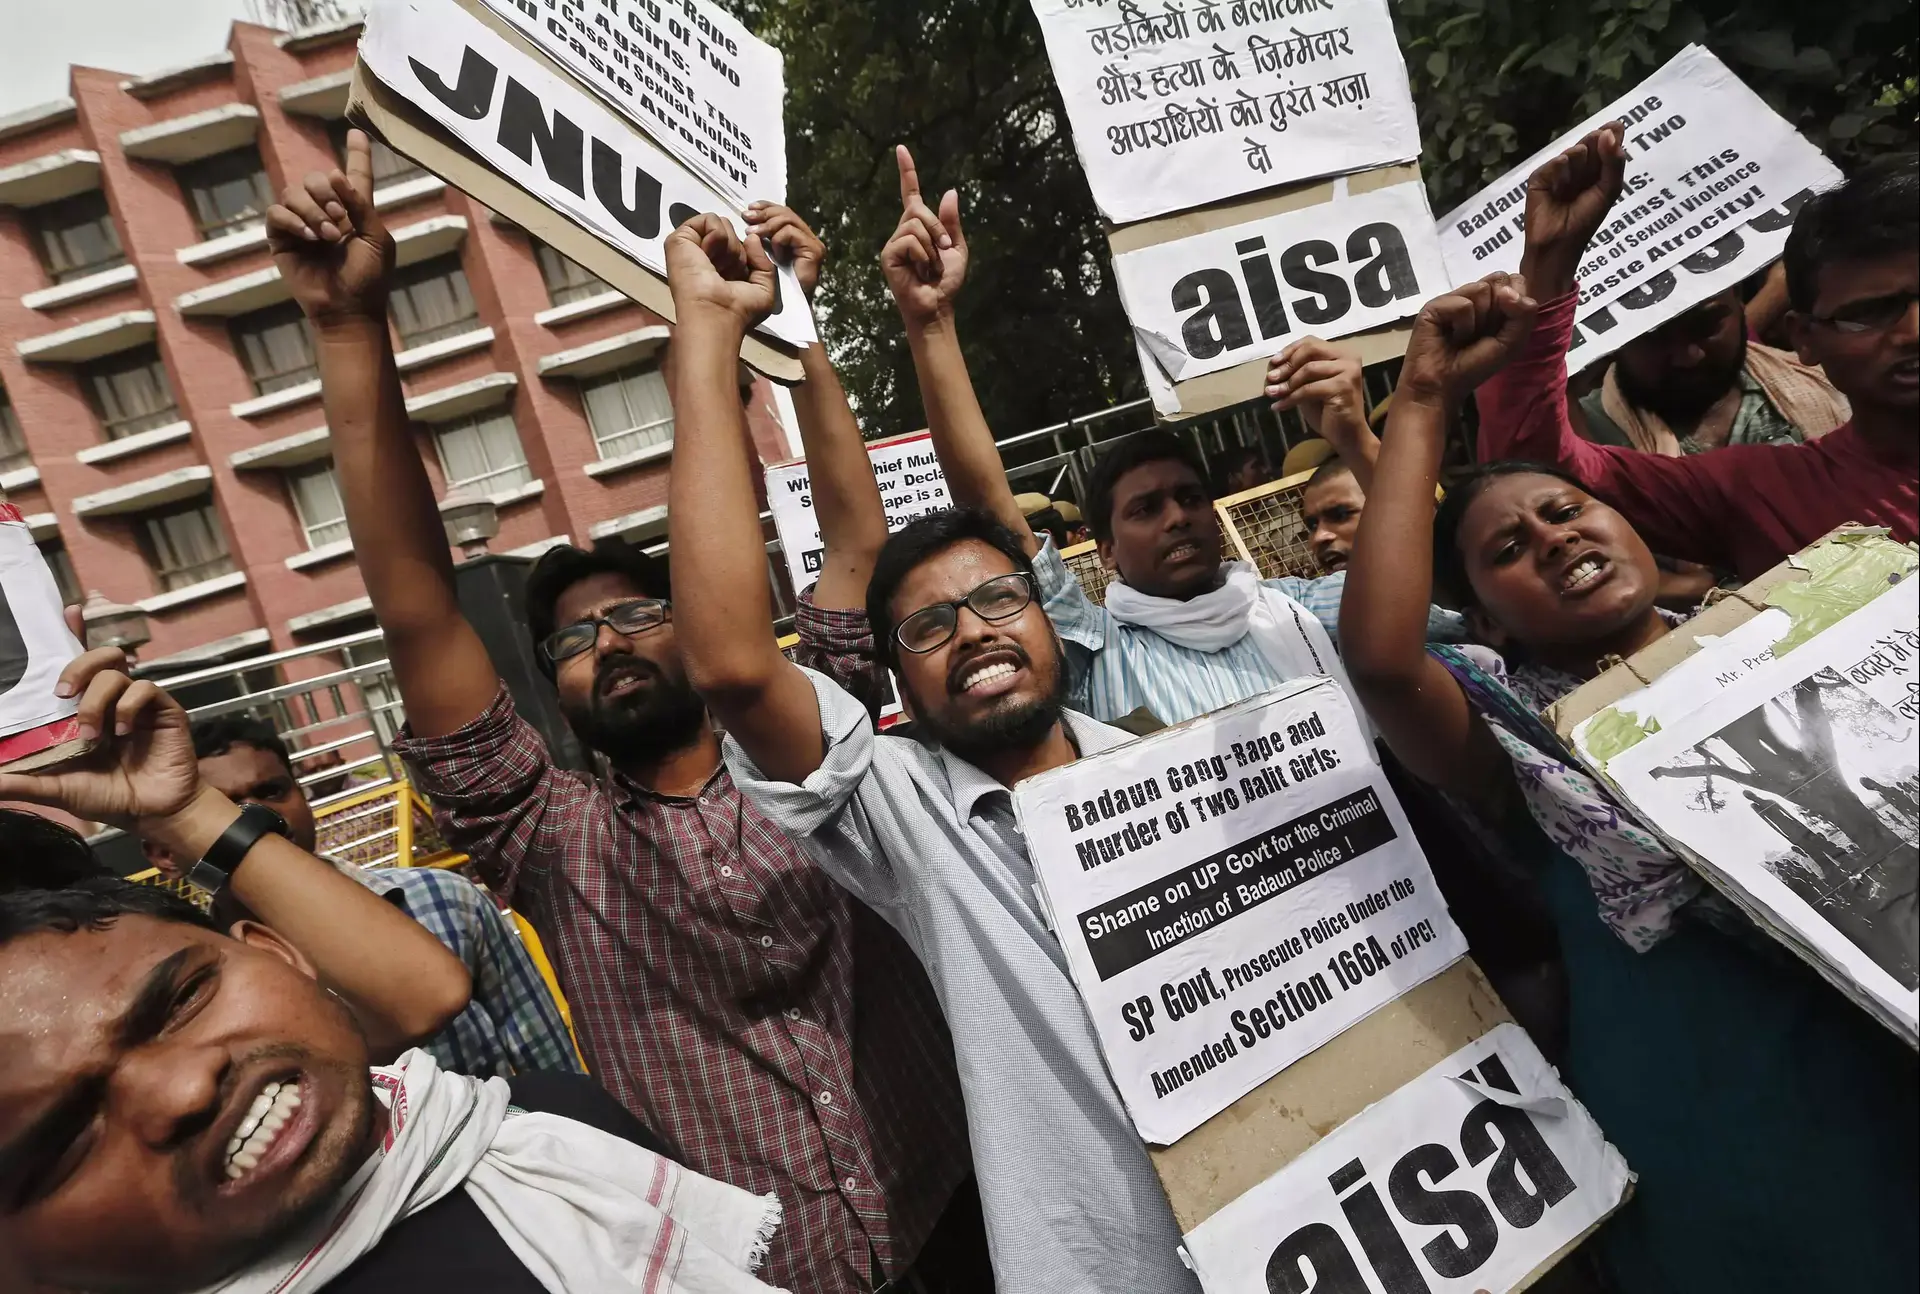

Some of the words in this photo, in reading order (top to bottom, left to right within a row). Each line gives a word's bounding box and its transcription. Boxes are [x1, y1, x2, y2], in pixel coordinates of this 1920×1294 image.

[595, 13, 696, 105] Against
[704, 100, 753, 151] This
[628, 11, 691, 77] Girls:
[669, 18, 692, 47] of
[697, 38, 741, 88] Two
[1096, 65, 1147, 105] और
[1148, 58, 1206, 98] हत्या
[1208, 42, 1242, 81] के
[546, 17, 634, 96] Caste
[640, 93, 748, 189] Atrocity!
[613, 48, 630, 71] of
[633, 64, 690, 119] Sexual
[692, 110, 758, 174] Violence
[1106, 97, 1225, 156] अपराधियों
[1225, 89, 1264, 128] को
[1265, 80, 1317, 132] तुरंत
[1317, 72, 1371, 111] सज़ा
[1242, 136, 1273, 174] दो
[1472, 225, 1513, 260] and
[1630, 114, 1687, 152] Two
[1677, 148, 1740, 187] This
[1608, 242, 1627, 259] of
[1624, 206, 1684, 248] Sexual
[1679, 161, 1761, 213] Violence
[1646, 185, 1766, 263] Atrocity!
[1171, 222, 1421, 360] aisa
[873, 458, 903, 475] hief
[878, 480, 896, 492] av
[884, 494, 912, 509] ape
[916, 489, 931, 501] is
[934, 487, 944, 498] a
[1715, 669, 1744, 688] Mr.
[1064, 776, 1163, 833] Badaun
[1166, 731, 1285, 794] Gang-Rape
[1286, 711, 1326, 748] and
[1074, 815, 1162, 872] Murder
[1165, 800, 1191, 836] of
[1190, 786, 1240, 823] Two
[1239, 764, 1290, 804] Dalit
[1289, 746, 1342, 783] Girls:
[1085, 895, 1161, 940] Shame
[1164, 879, 1191, 904] on
[1192, 863, 1220, 890] UP
[1225, 841, 1273, 875] Govt
[1273, 832, 1294, 856] for
[1295, 821, 1320, 845] the
[1319, 793, 1379, 832] Criminal
[1146, 904, 1214, 950] Inaction
[1215, 892, 1233, 917] of
[1236, 865, 1297, 906] Badaun
[1294, 844, 1342, 880] Police
[1121, 994, 1155, 1043] SP
[1160, 966, 1227, 1022] Govt,
[1223, 936, 1304, 993] Prosecute
[1300, 910, 1350, 950] Police
[1346, 890, 1391, 924] Under
[1391, 876, 1416, 903] the
[1150, 1032, 1239, 1100] Amended
[1231, 969, 1333, 1049] Section
[1327, 935, 1391, 992] 166A
[1390, 934, 1405, 960] of
[1405, 918, 1437, 951] IPC!
[1265, 1099, 1578, 1294] aisa
